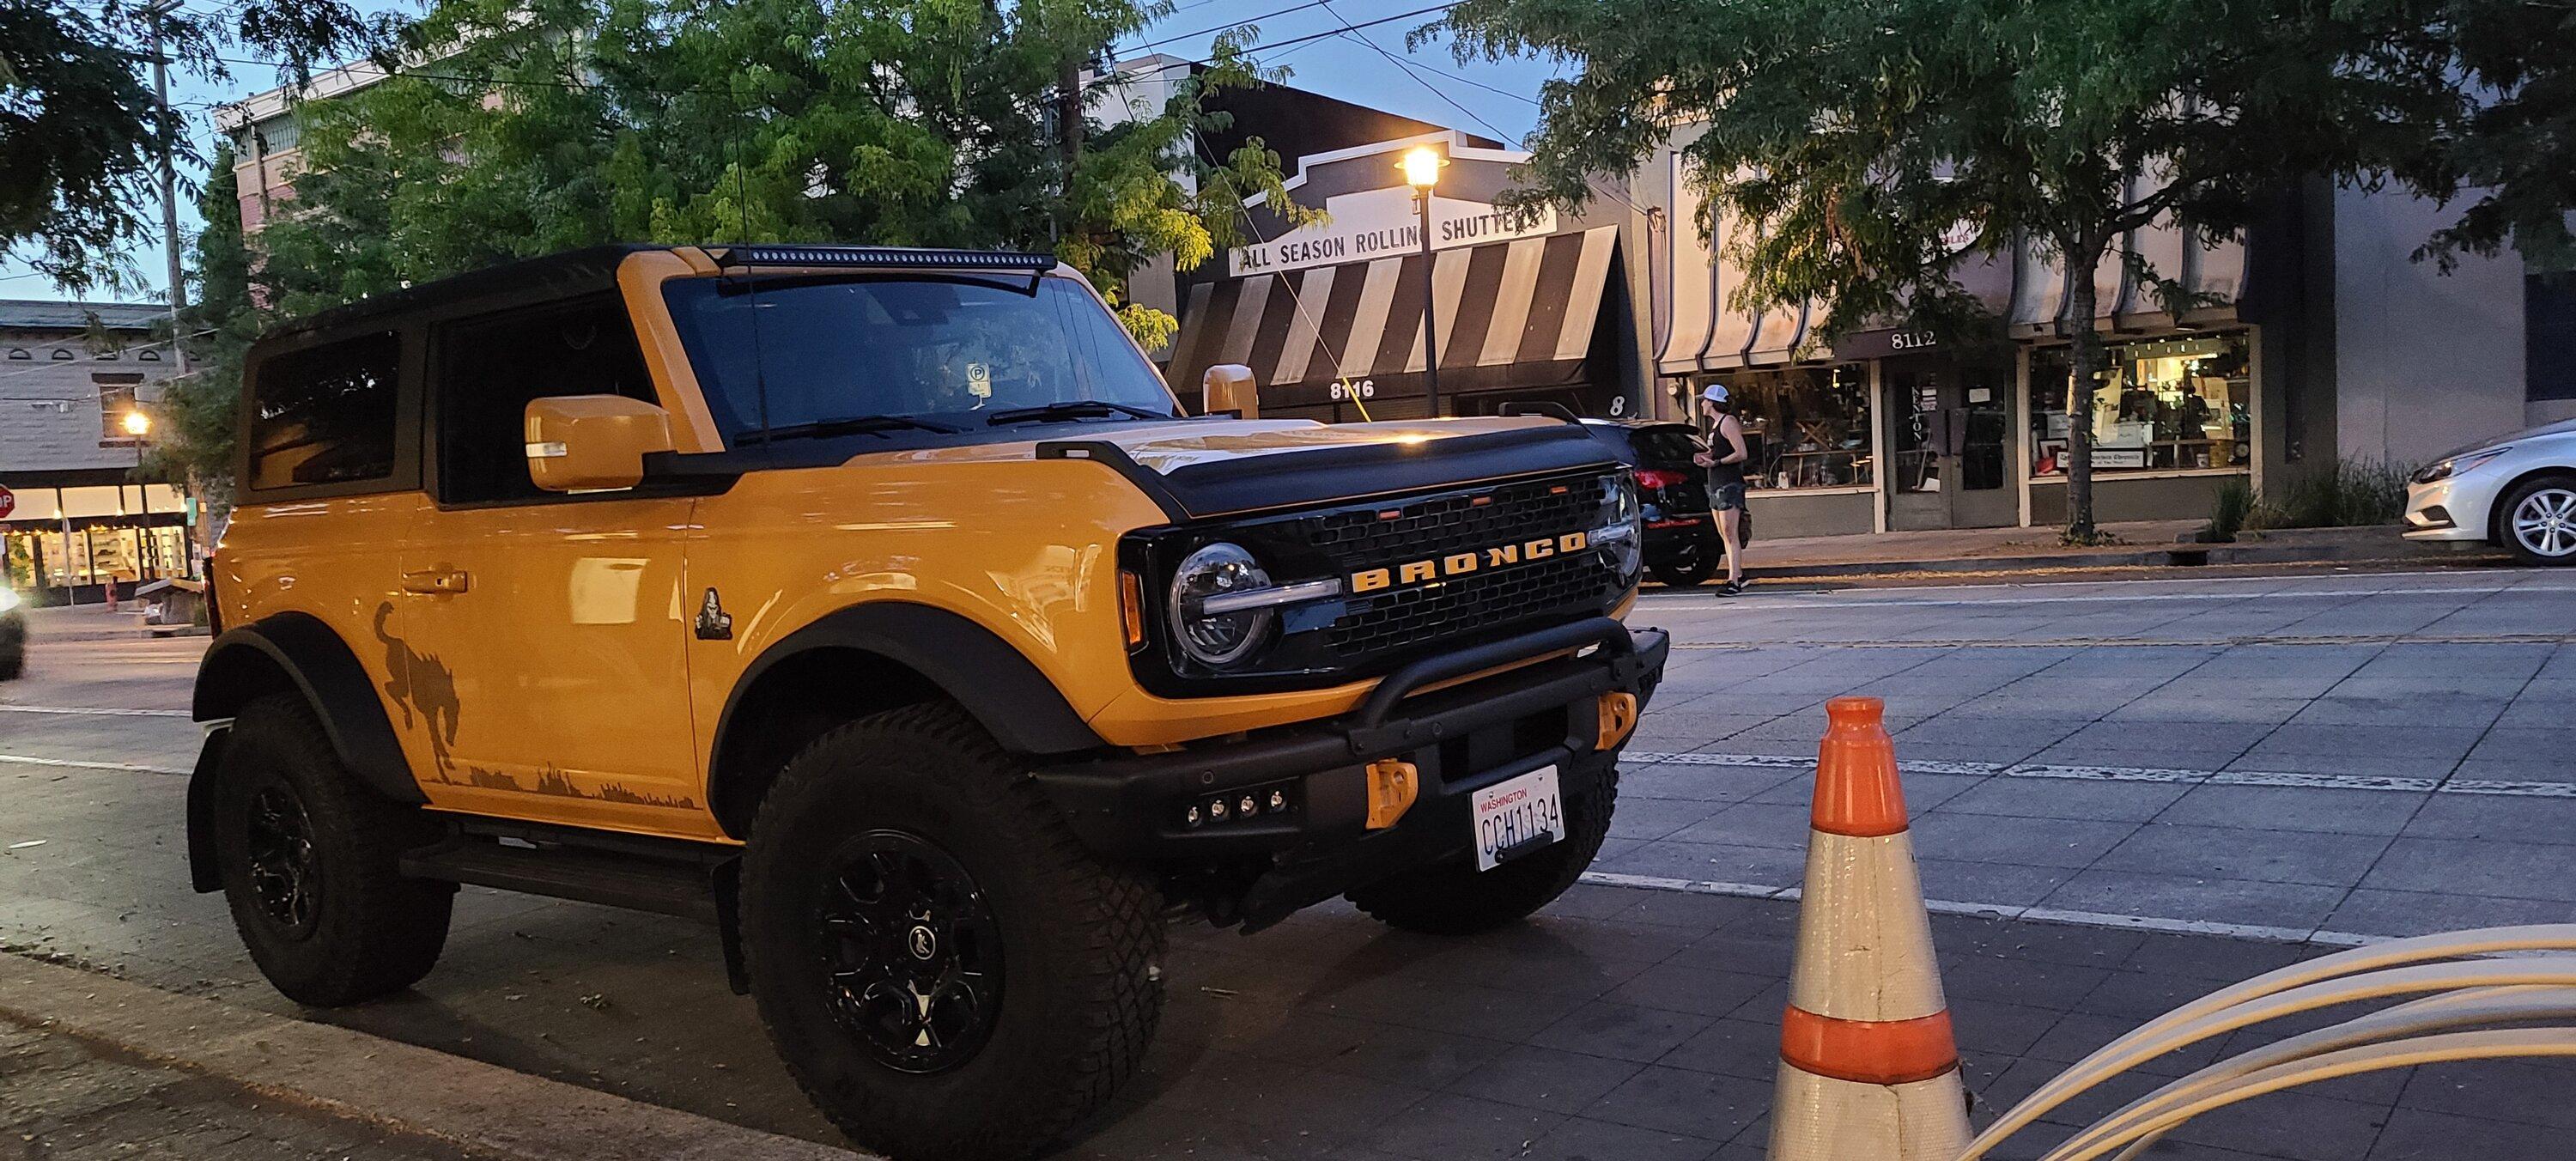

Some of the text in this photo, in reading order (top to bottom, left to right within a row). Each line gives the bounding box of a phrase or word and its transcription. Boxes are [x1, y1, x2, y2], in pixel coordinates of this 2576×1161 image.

[1242, 210, 1538, 269] ALL SEASON ROLLIN SHUTTE
[1891, 330, 1936, 350] 8112
[1330, 380, 1375, 400] 8116
[1352, 531, 1587, 593] BRONCO
[1480, 787, 1528, 813] WASHINGTON
[1482, 793, 1558, 855] CCH1134
